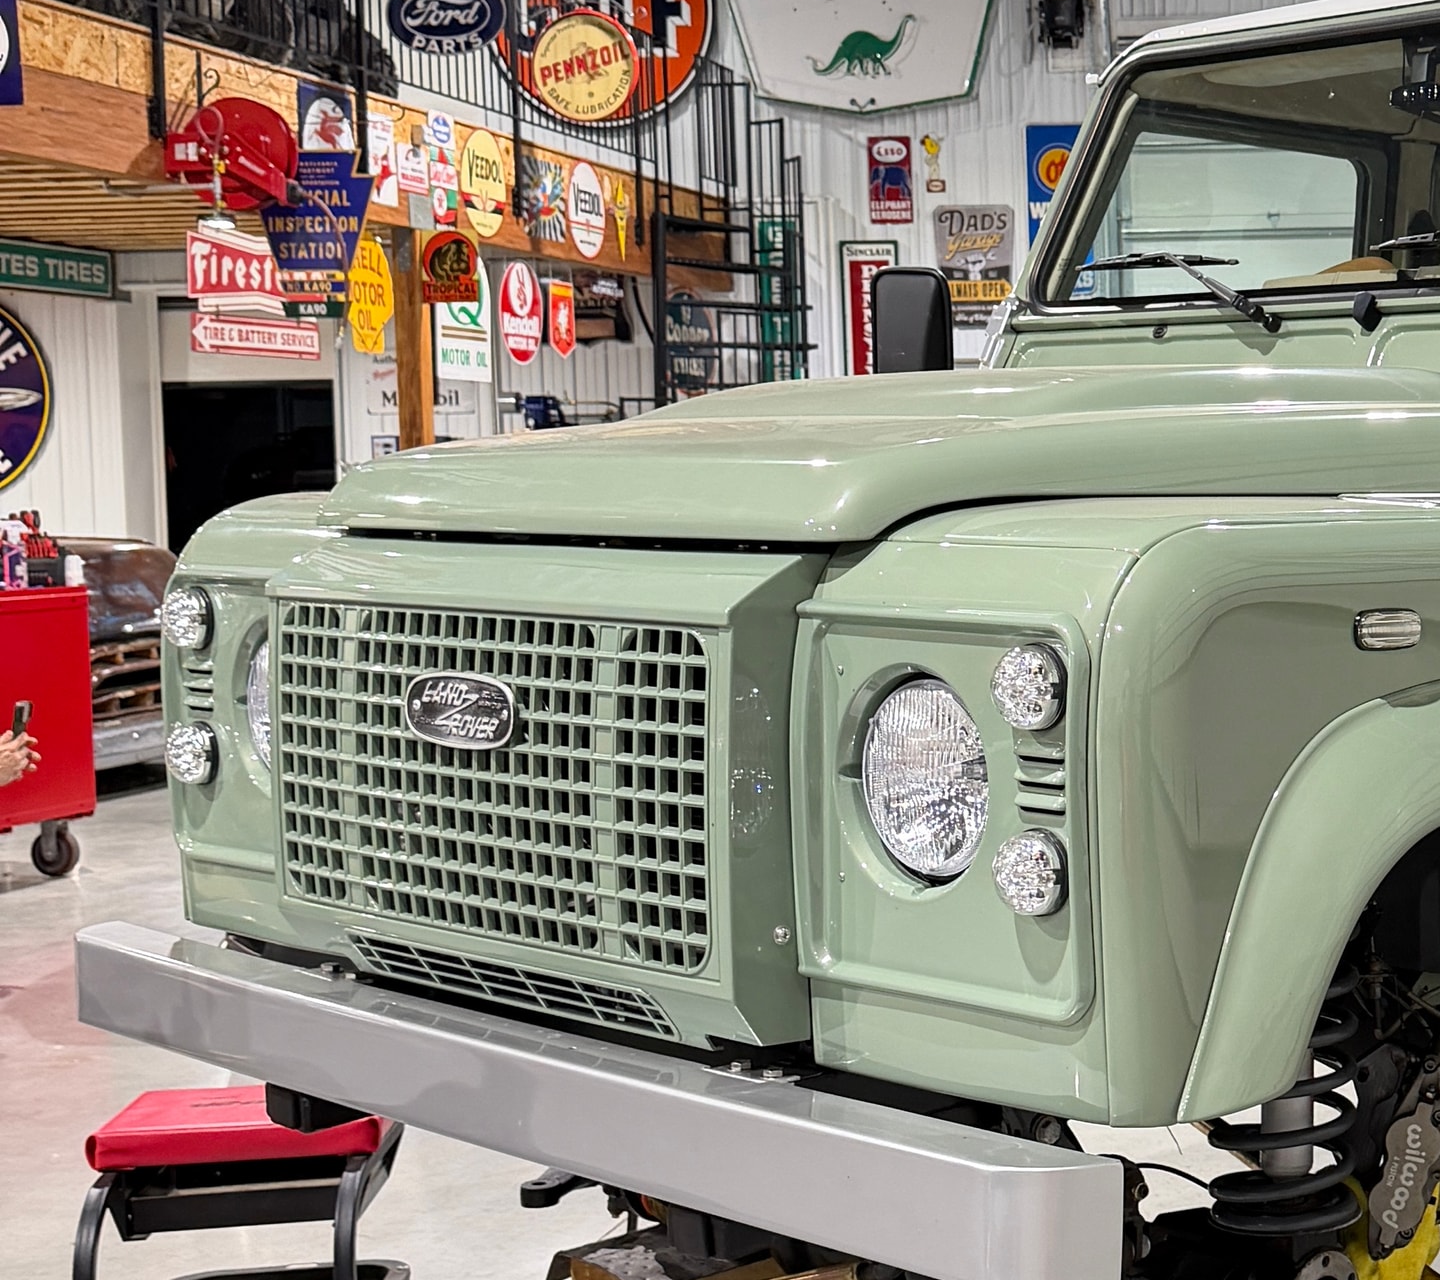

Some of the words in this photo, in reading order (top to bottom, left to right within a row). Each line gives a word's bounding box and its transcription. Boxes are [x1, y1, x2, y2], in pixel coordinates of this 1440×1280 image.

[411, 32, 483, 55] PARTS
[540, 40, 630, 88] PENNZOIL
[547, 87, 572, 111] SAFE
[574, 68, 631, 115] LUBRICATION
[467, 147, 503, 188] VEEDOL
[572, 182, 603, 217] VEEDOL
[871, 200, 911, 210] ELEPHANT
[268, 216, 359, 233] INSPECTON
[938, 210, 1008, 235] DAD'S
[846, 245, 893, 257] SINCLAIR
[945, 232, 1004, 260] Garage
[0, 253, 39, 277] TES
[44, 257, 106, 285] TIRES
[353, 281, 386, 308] OTOR
[950, 282, 979, 298] LWAYS
[982, 282, 1006, 298] OPEN
[357, 308, 378, 332] OIL
[202, 325, 226, 341] TIRE
[237, 327, 279, 346] BATTERY
[280, 331, 316, 348] SERVICE
[441, 347, 471, 367] MOTOR
[475, 350, 489, 368] OIL
[381, 389, 460, 407] Mbil
[421, 681, 470, 706] LAND
[446, 713, 500, 740] ROVER
[1381, 1123, 1427, 1230] wilwood
